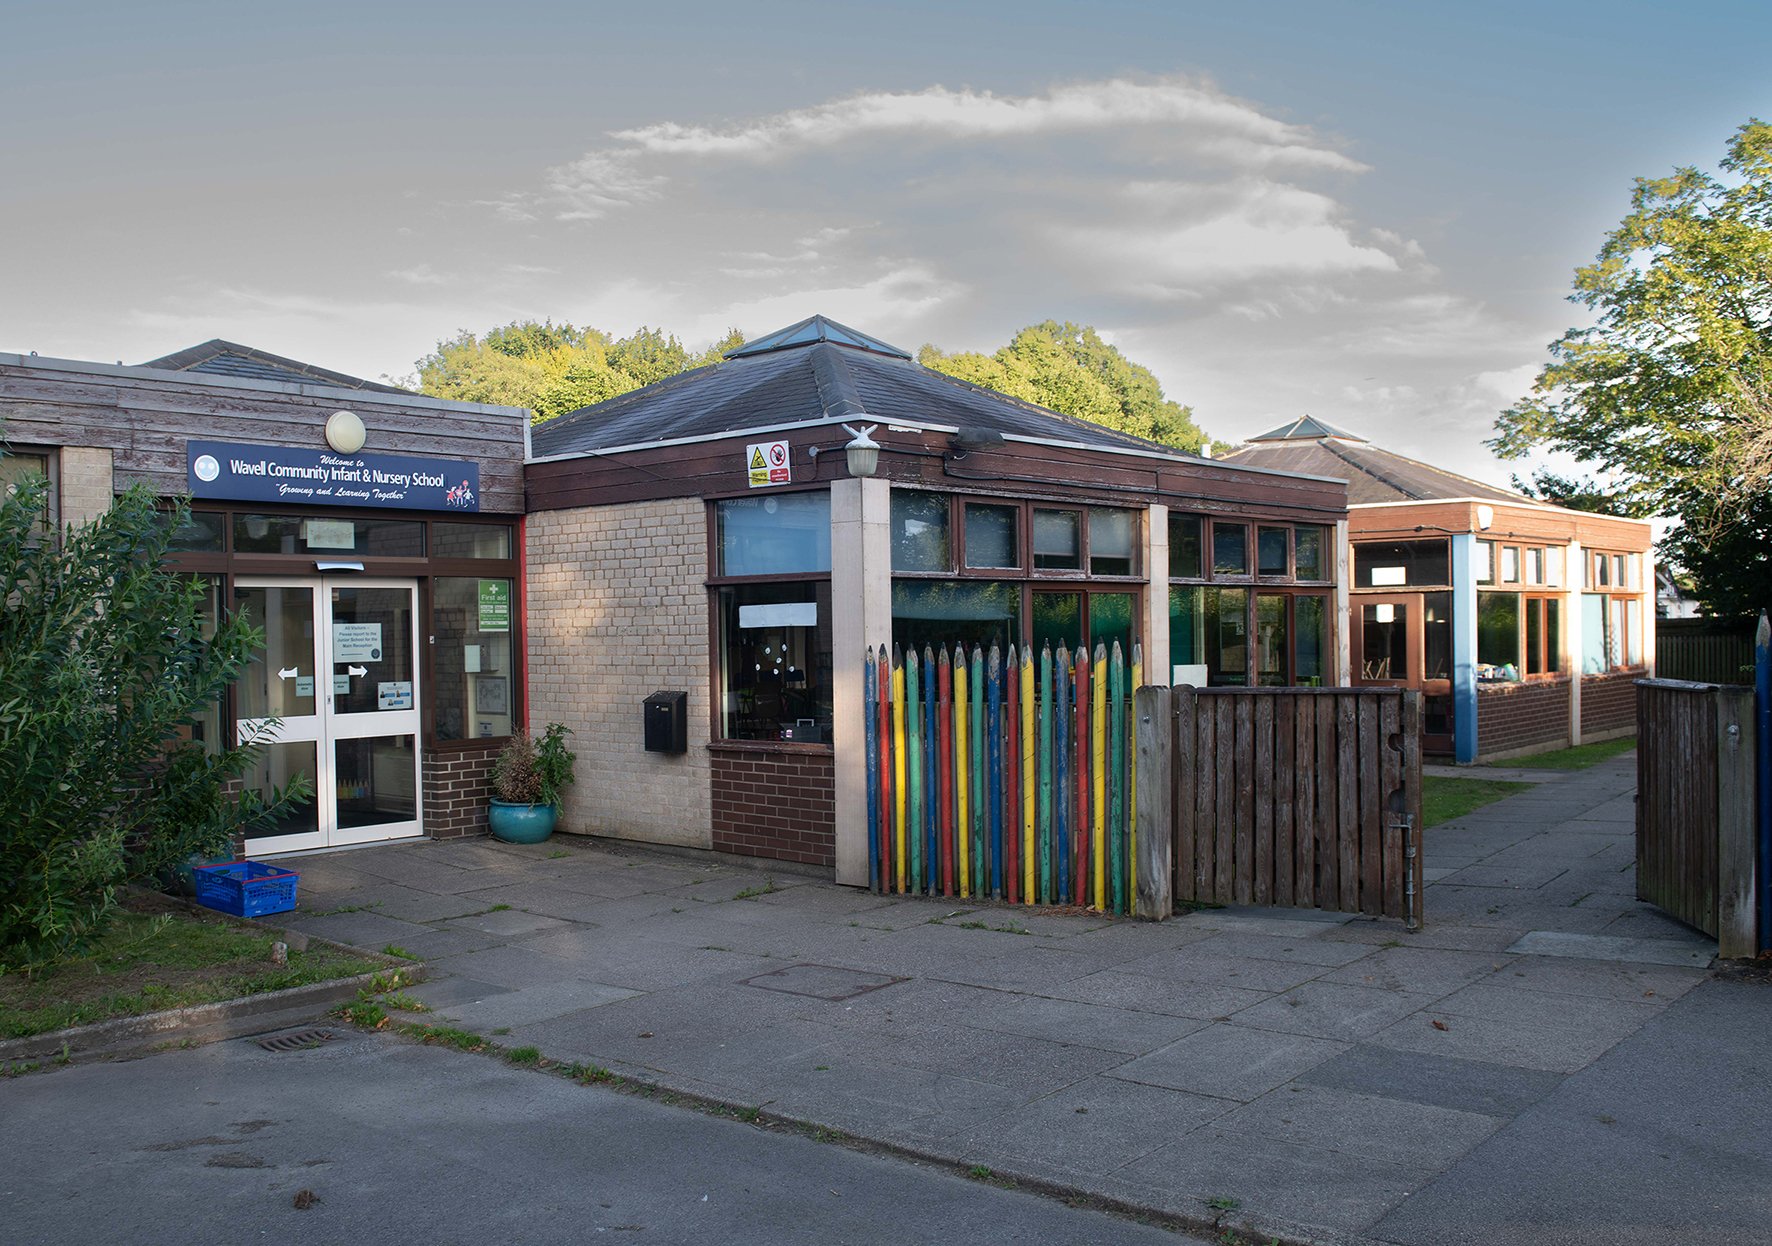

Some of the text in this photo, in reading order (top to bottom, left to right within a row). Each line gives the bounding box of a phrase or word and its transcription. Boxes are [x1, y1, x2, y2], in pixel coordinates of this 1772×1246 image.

[319, 455, 365, 467] Welcome to
[230, 459, 444, 488] Wavell Community Infant & Nursery School
[316, 487, 332, 496] and
[334, 487, 370, 500] Learning
